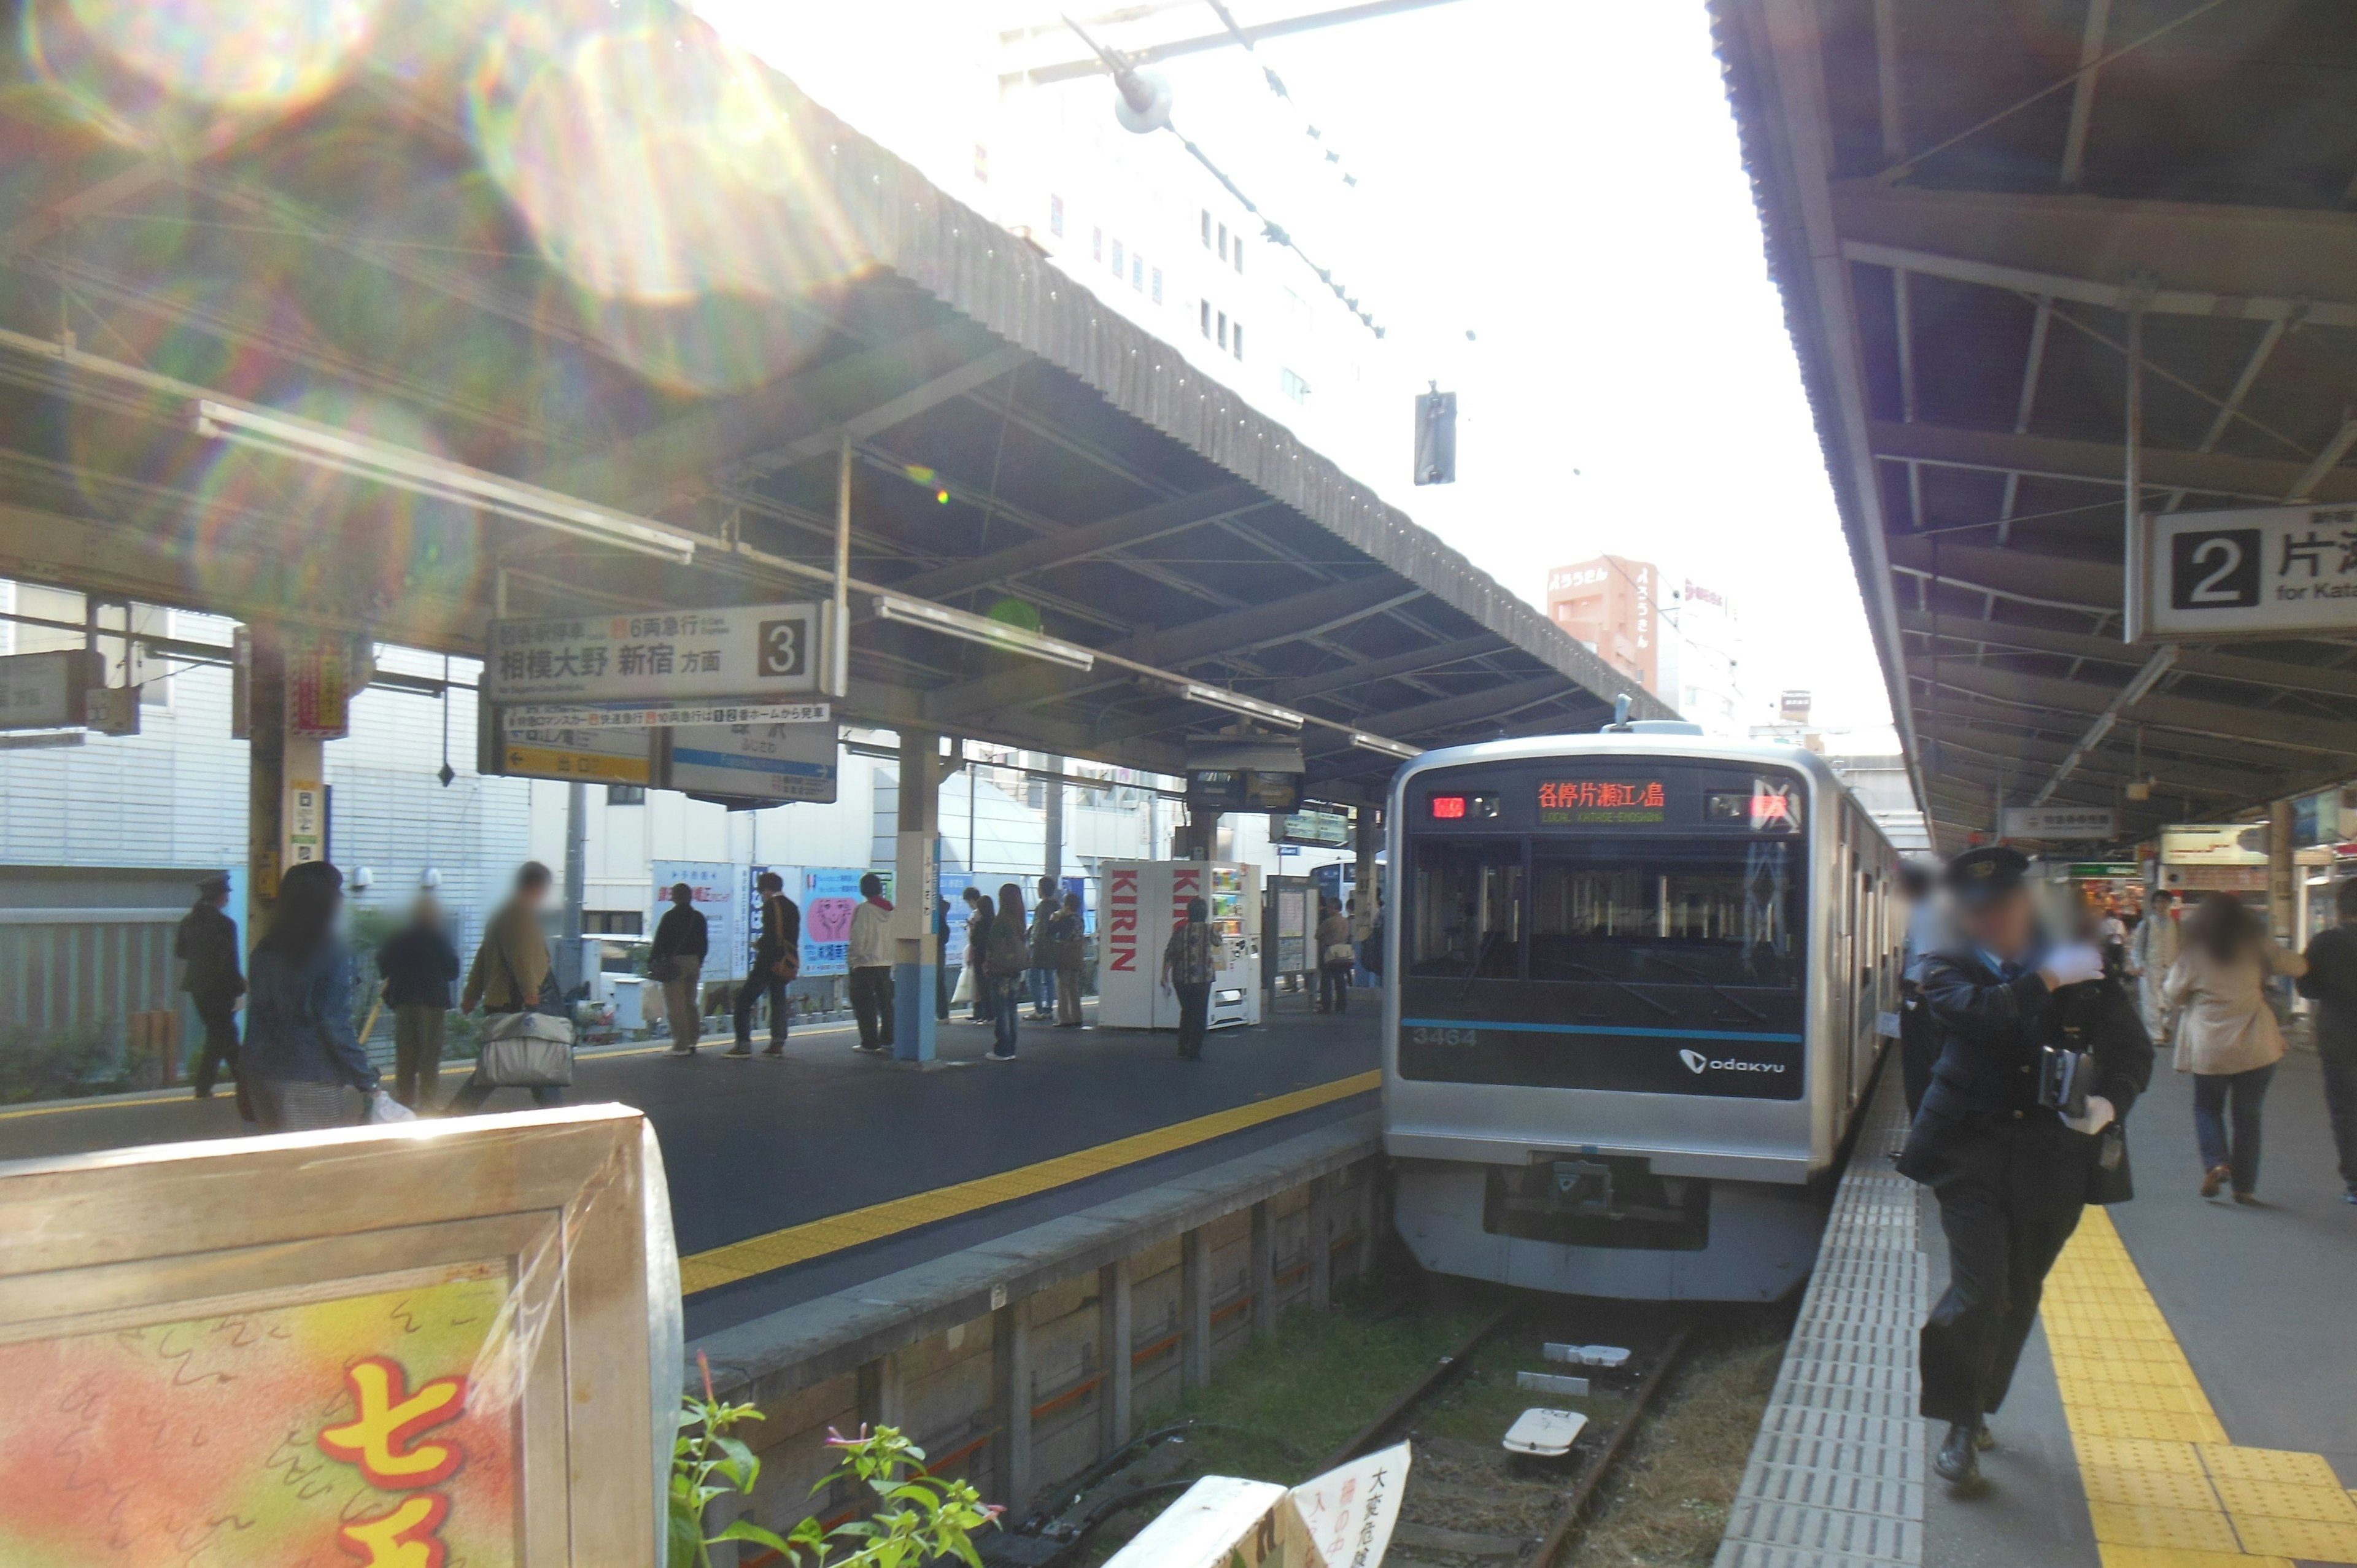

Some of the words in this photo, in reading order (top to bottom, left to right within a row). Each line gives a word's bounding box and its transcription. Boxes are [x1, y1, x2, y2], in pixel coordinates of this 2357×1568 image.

[1561, 568, 1608, 589] ろうきん
[2191, 538, 2241, 602] 2
[2277, 585, 2306, 600] for
[630, 615, 698, 638] 6両急行
[1637, 585, 1648, 648] ろうきん
[500, 647, 608, 680] 相模大野
[618, 643, 674, 675] 新宿
[681, 650, 721, 673] 方面
[768, 625, 795, 673] 3
[1110, 870, 1138, 972] KIRIN
[1413, 1027, 1477, 1046] 3464
[1709, 1052, 1785, 1073] odakyu
